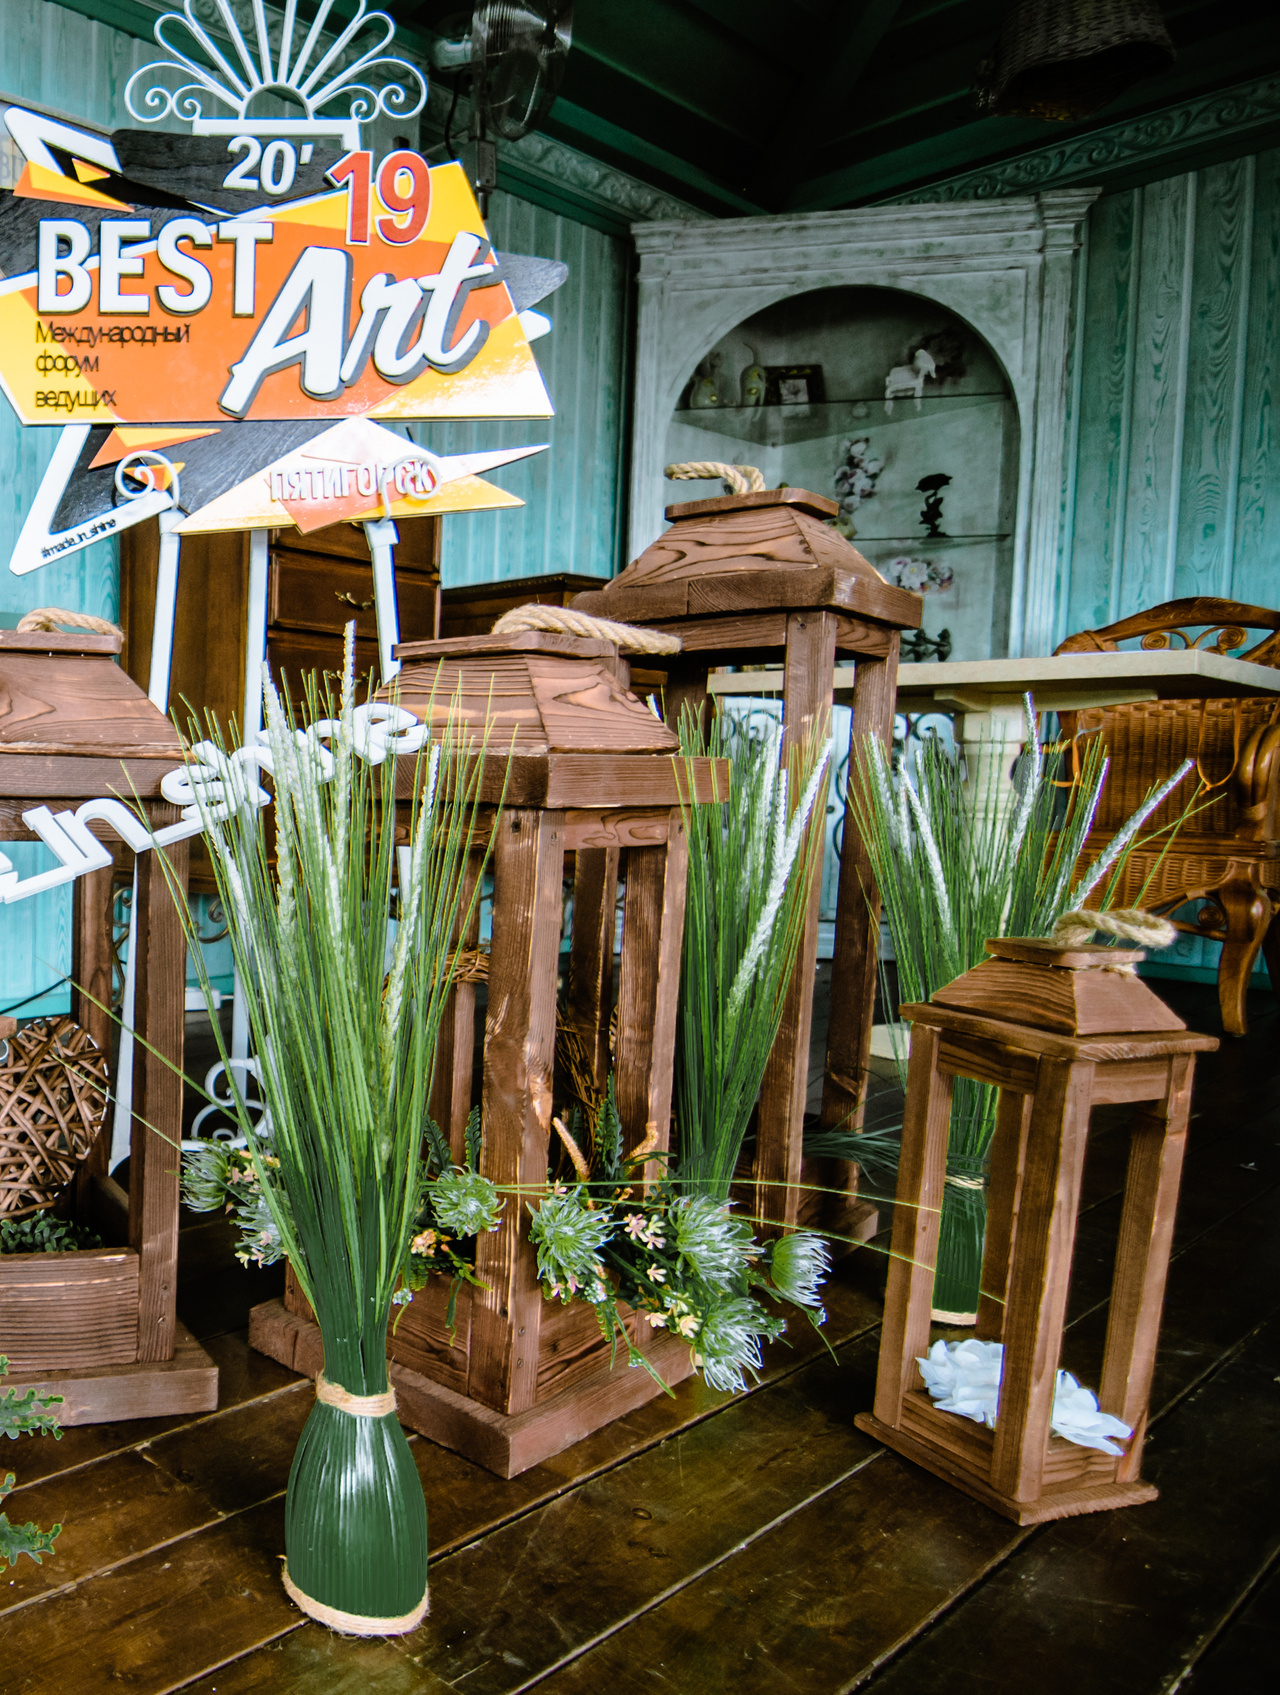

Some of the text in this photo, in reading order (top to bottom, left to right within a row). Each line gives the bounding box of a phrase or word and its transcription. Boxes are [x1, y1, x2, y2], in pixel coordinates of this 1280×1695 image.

[323, 147, 432, 247] 19
[37, 217, 275, 318] BEST
[35, 321, 192, 348] Международный
[218, 230, 502, 419] Art
[35, 349, 100, 378] форум
[34, 390, 117, 413] ведущих
[269, 460, 435, 503] ПЯТИГОРСК
